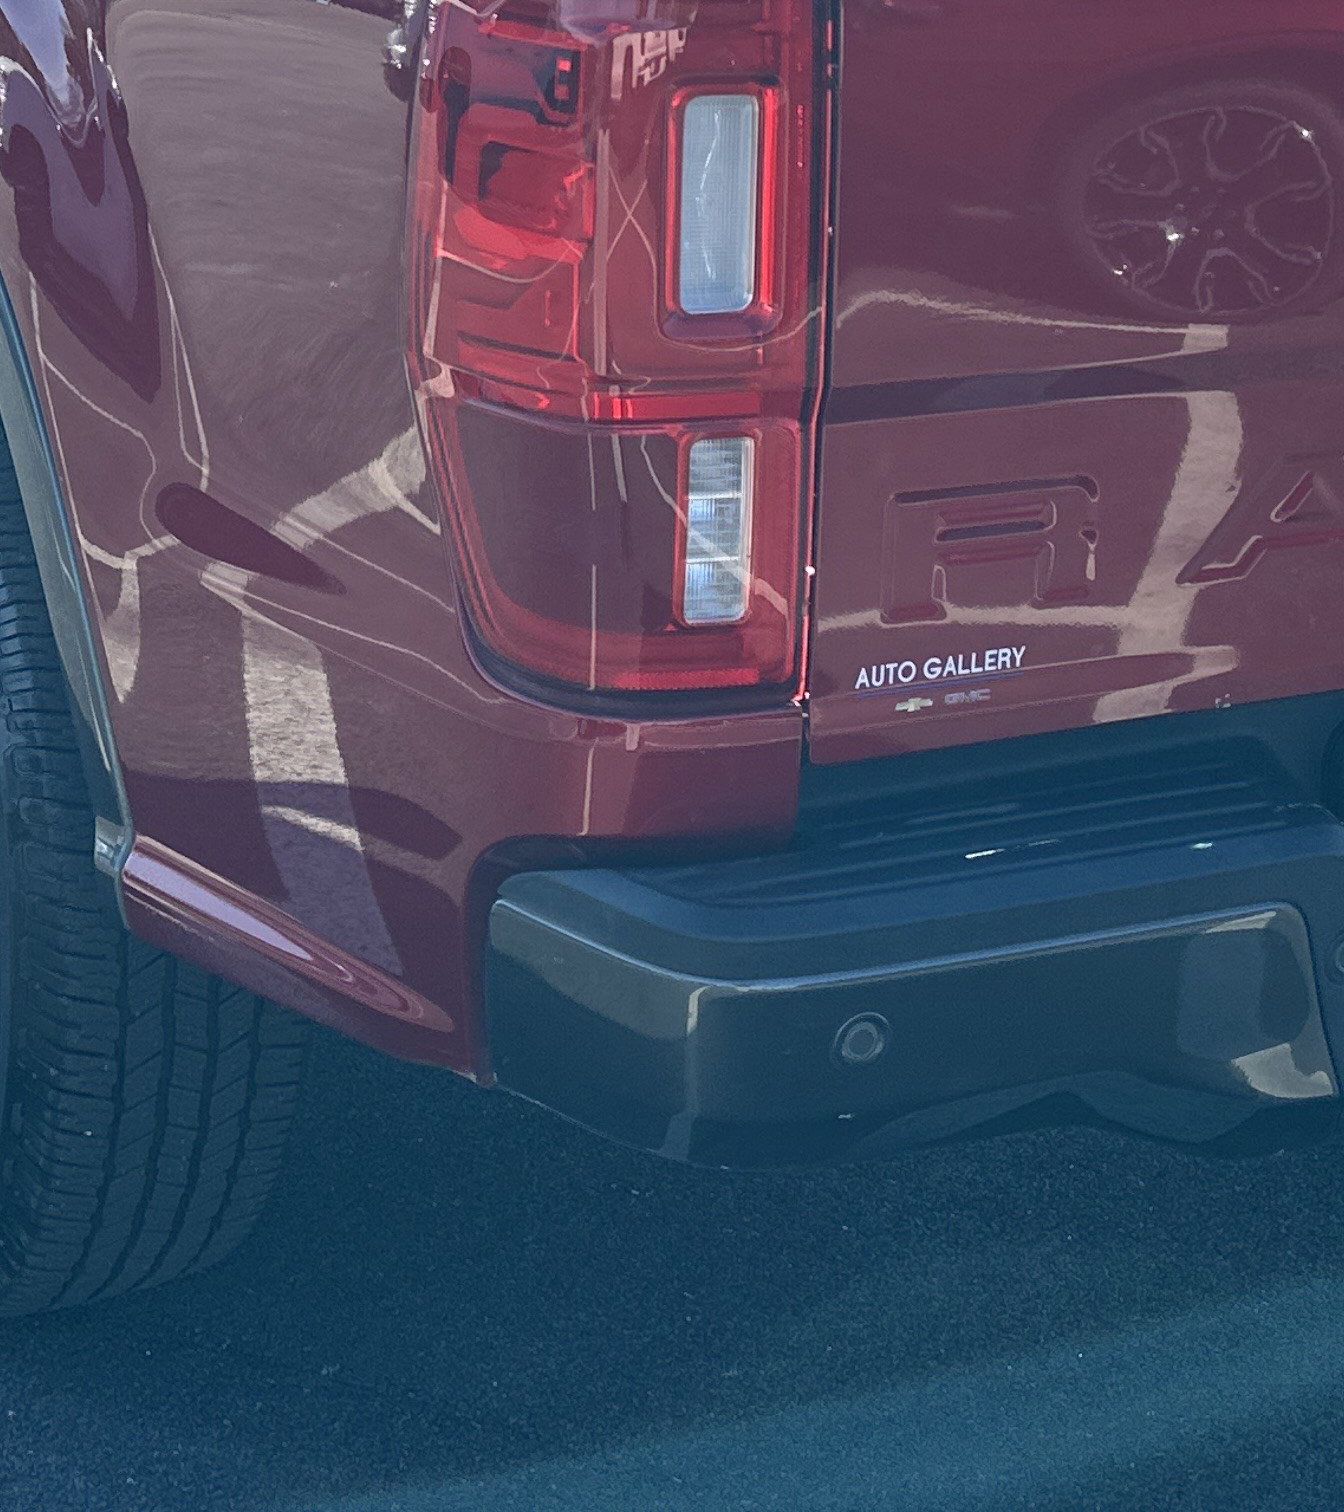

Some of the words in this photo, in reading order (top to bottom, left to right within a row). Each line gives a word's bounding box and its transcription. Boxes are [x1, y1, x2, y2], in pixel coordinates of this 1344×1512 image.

[854, 660, 917, 690] AUTO
[923, 645, 1026, 680] GALLERY
[944, 688, 992, 705] GMC
